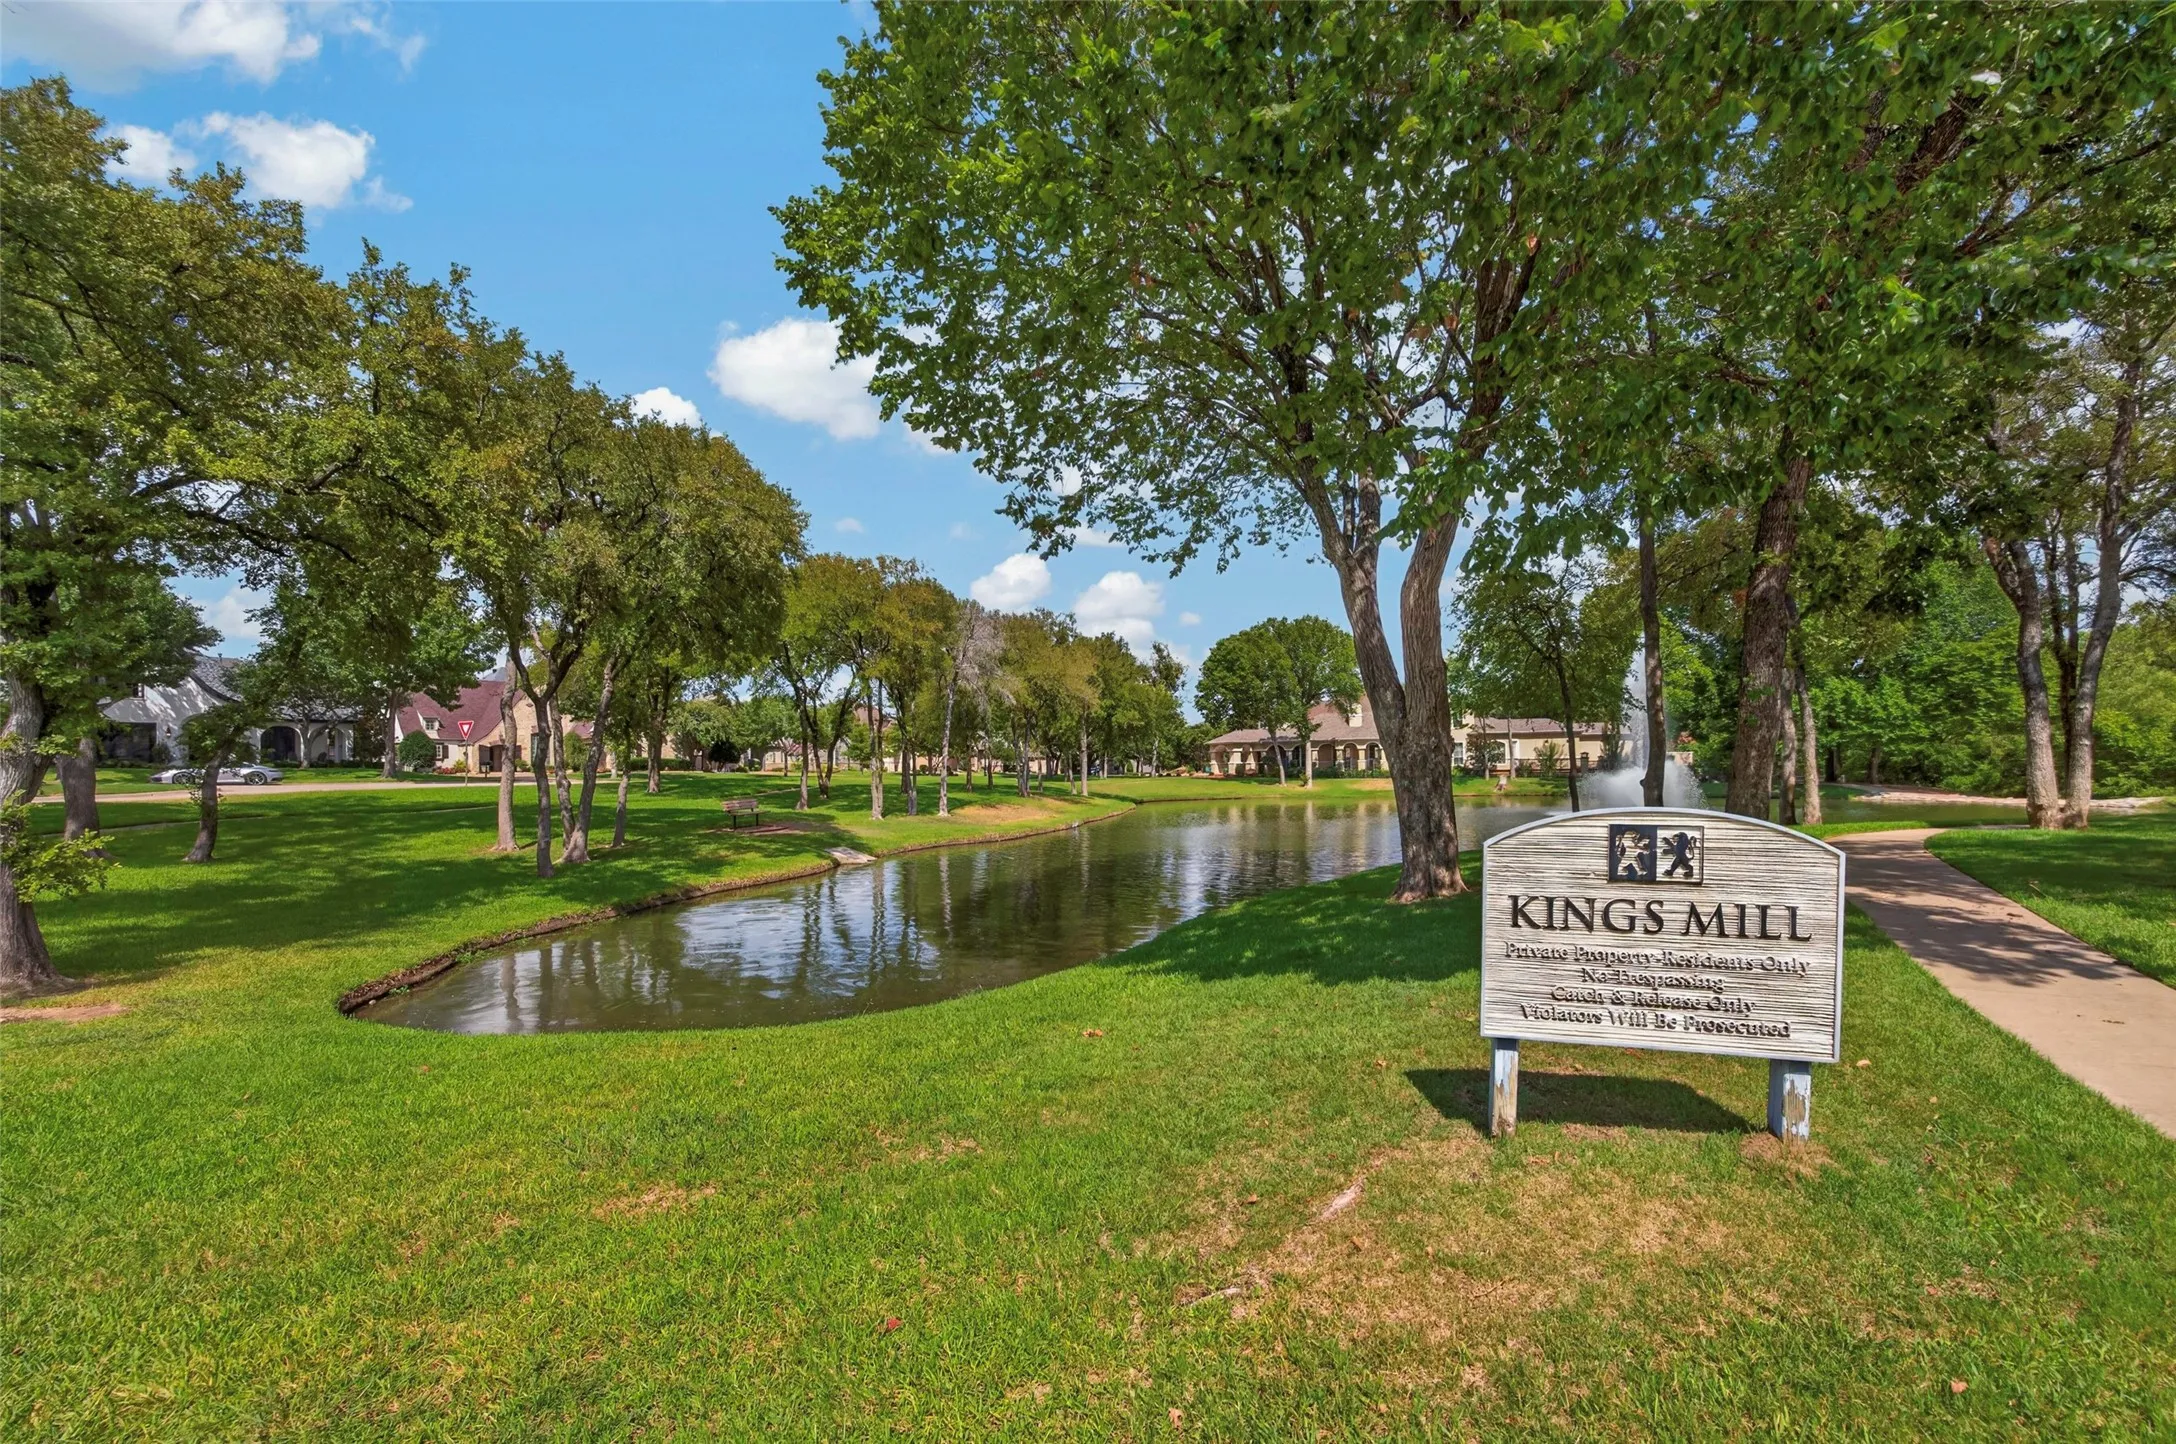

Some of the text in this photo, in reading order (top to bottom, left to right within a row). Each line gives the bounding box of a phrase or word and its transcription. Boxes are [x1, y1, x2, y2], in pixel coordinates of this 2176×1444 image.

[1508, 895, 1812, 942] KINGS MILL
[1504, 941, 1569, 959] Private
[1761, 956, 1811, 978] Only
[1582, 967, 1725, 994] No Trespassing
[1551, 984, 1756, 1018] Catch & Release Only
[1520, 1003, 1791, 1038] Violators Will Be Prosecuted
